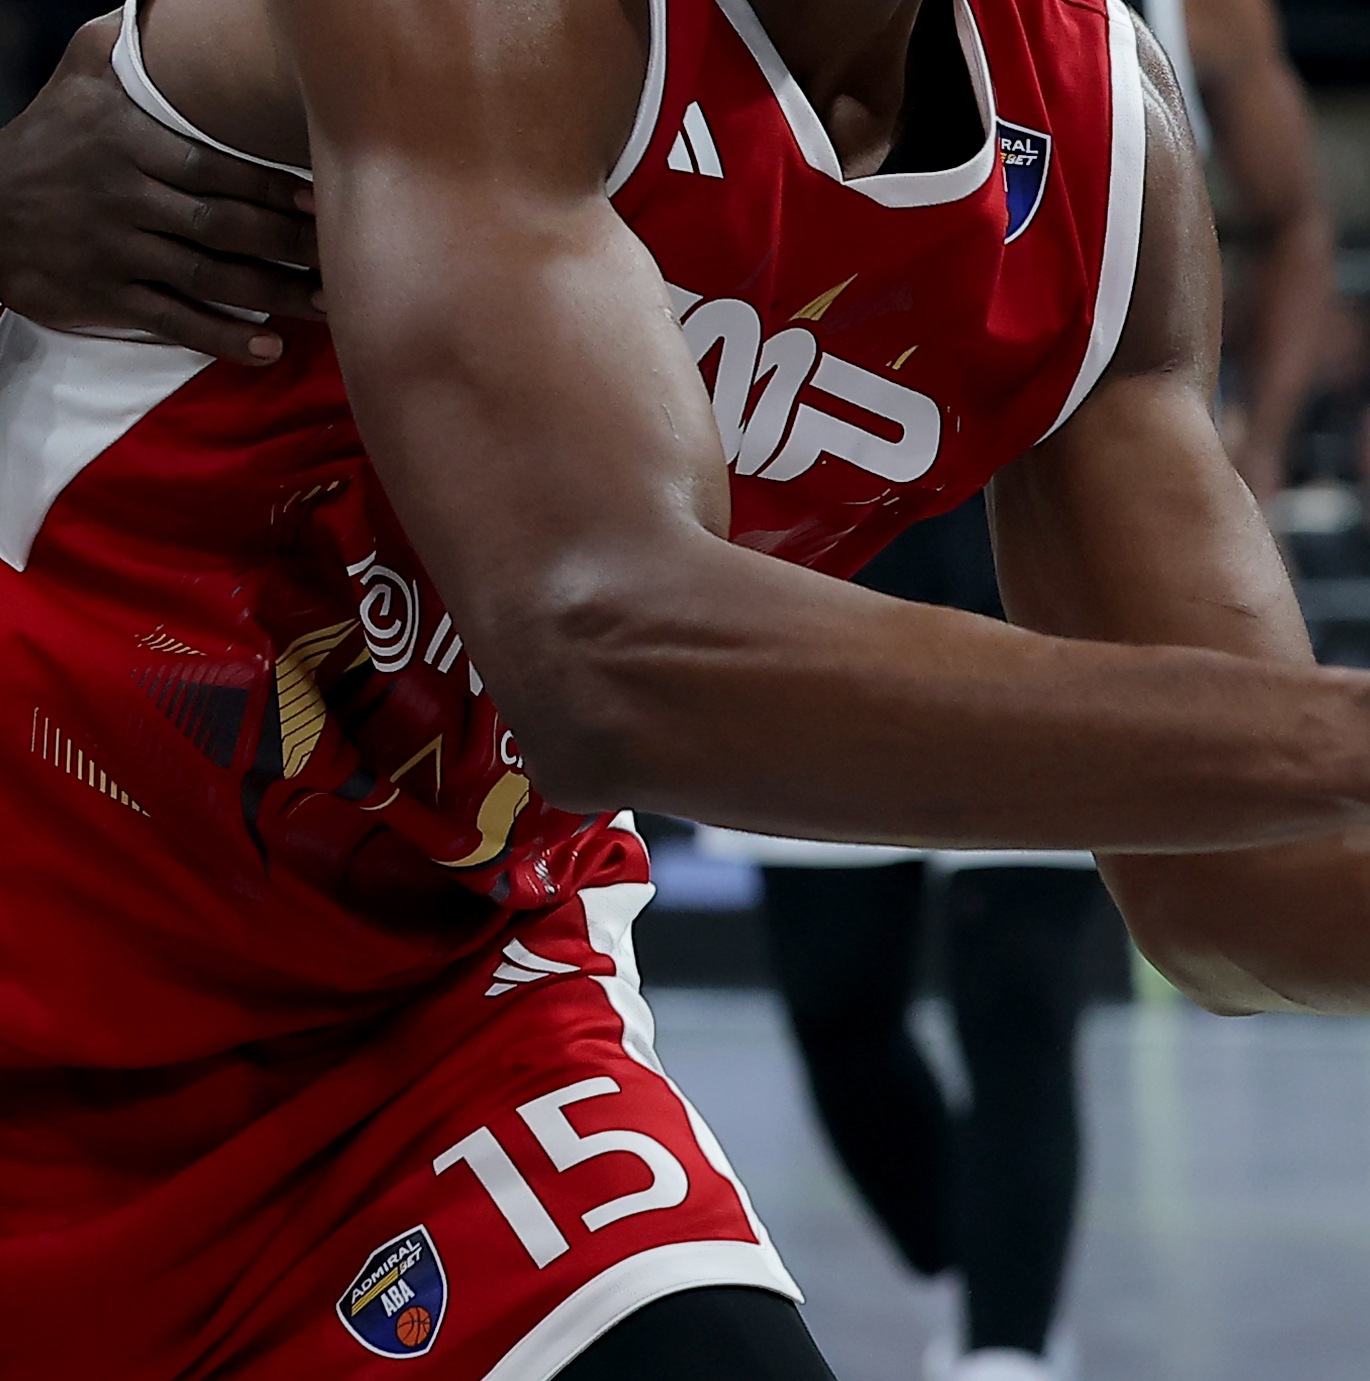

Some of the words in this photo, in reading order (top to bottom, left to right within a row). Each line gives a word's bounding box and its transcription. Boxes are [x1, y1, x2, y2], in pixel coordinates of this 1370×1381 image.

[1000, 137, 1039, 155] RAL
[665, 282, 942, 484] MP
[432, 1075, 690, 1270] 15
[350, 1238, 421, 1305] ADMIRAL
[398, 1245, 423, 1276] BET
[379, 1277, 417, 1318] ABA
